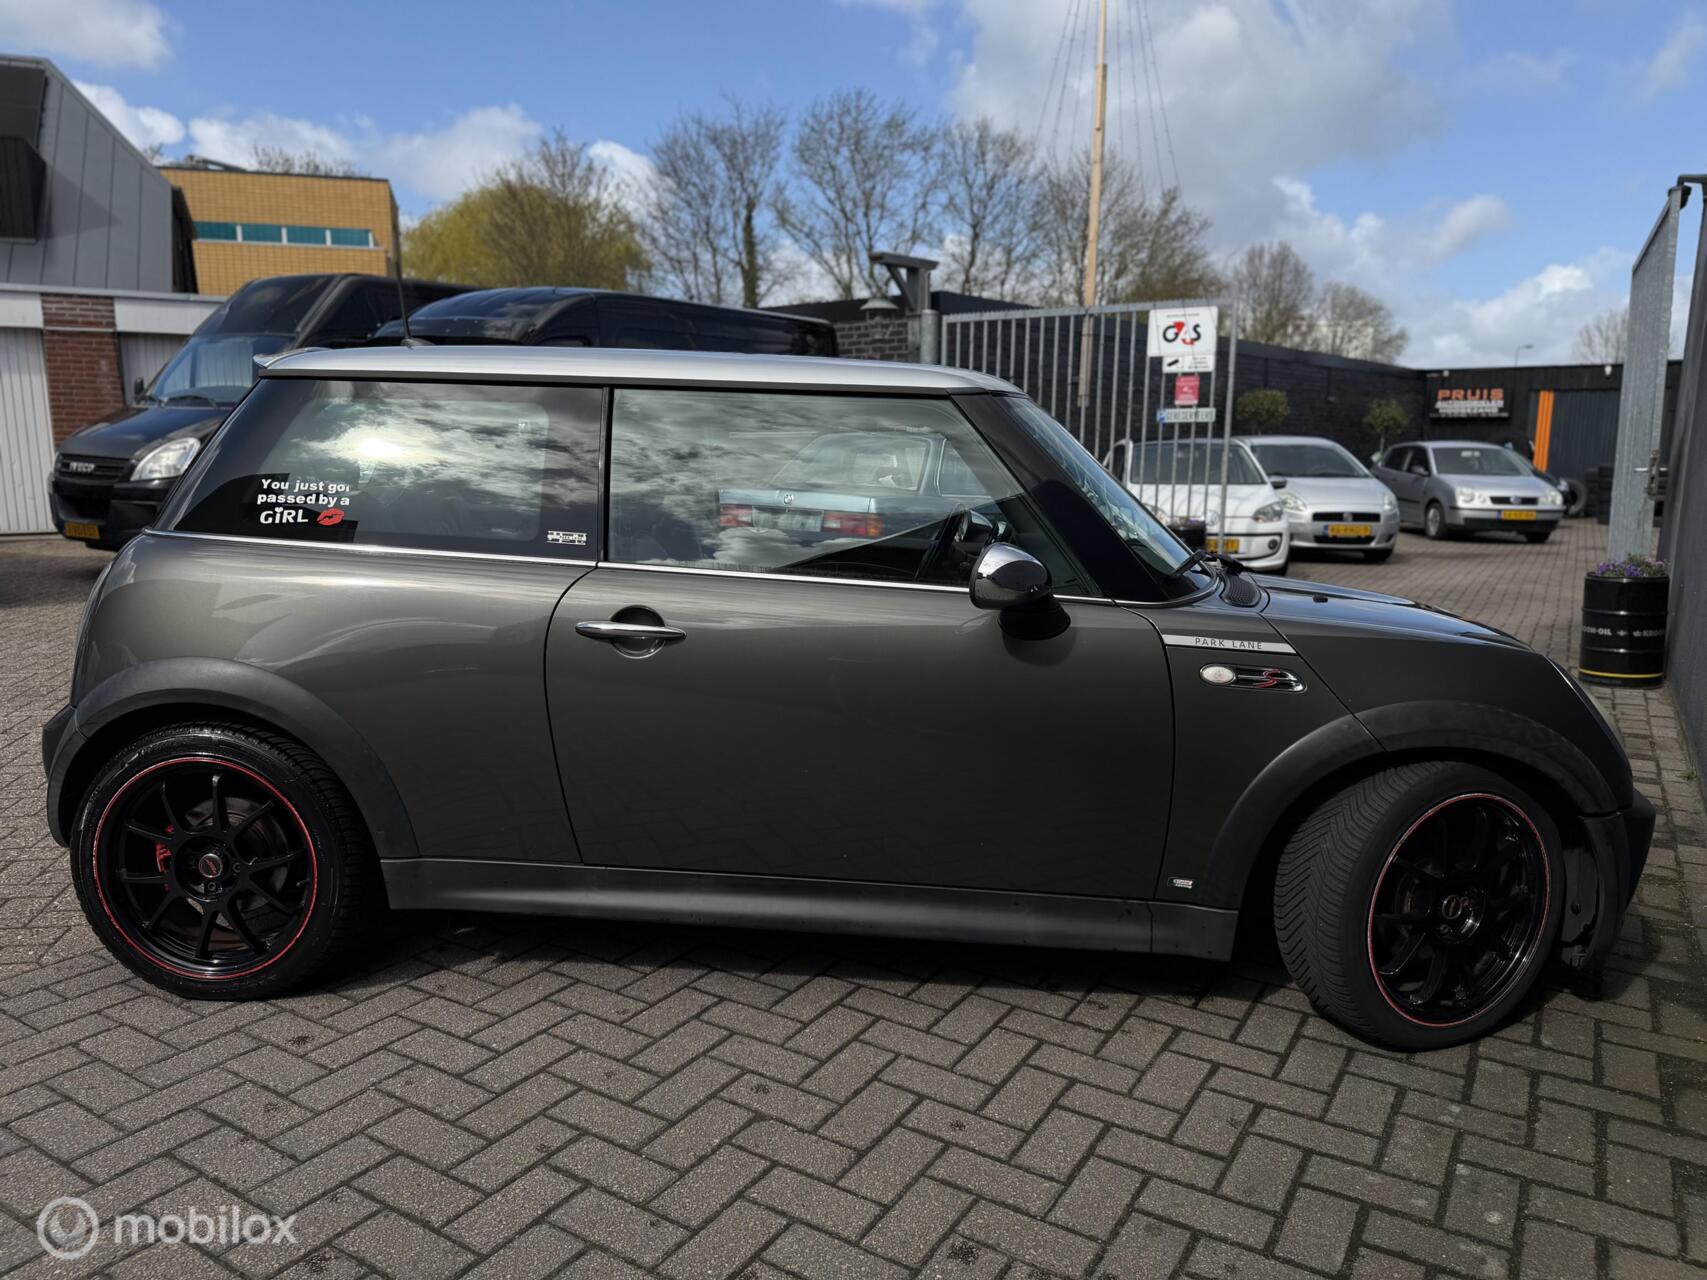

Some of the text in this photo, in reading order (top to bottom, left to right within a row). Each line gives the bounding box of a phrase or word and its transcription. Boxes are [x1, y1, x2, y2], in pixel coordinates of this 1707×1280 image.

[1437, 388, 1504, 400] PRUIS
[70, 461, 96, 472] IVECO
[261, 479, 290, 490] You
[293, 480, 325, 492] just
[257, 494, 350, 507] passed by a
[1195, 637, 1263, 650] PARK LANE
